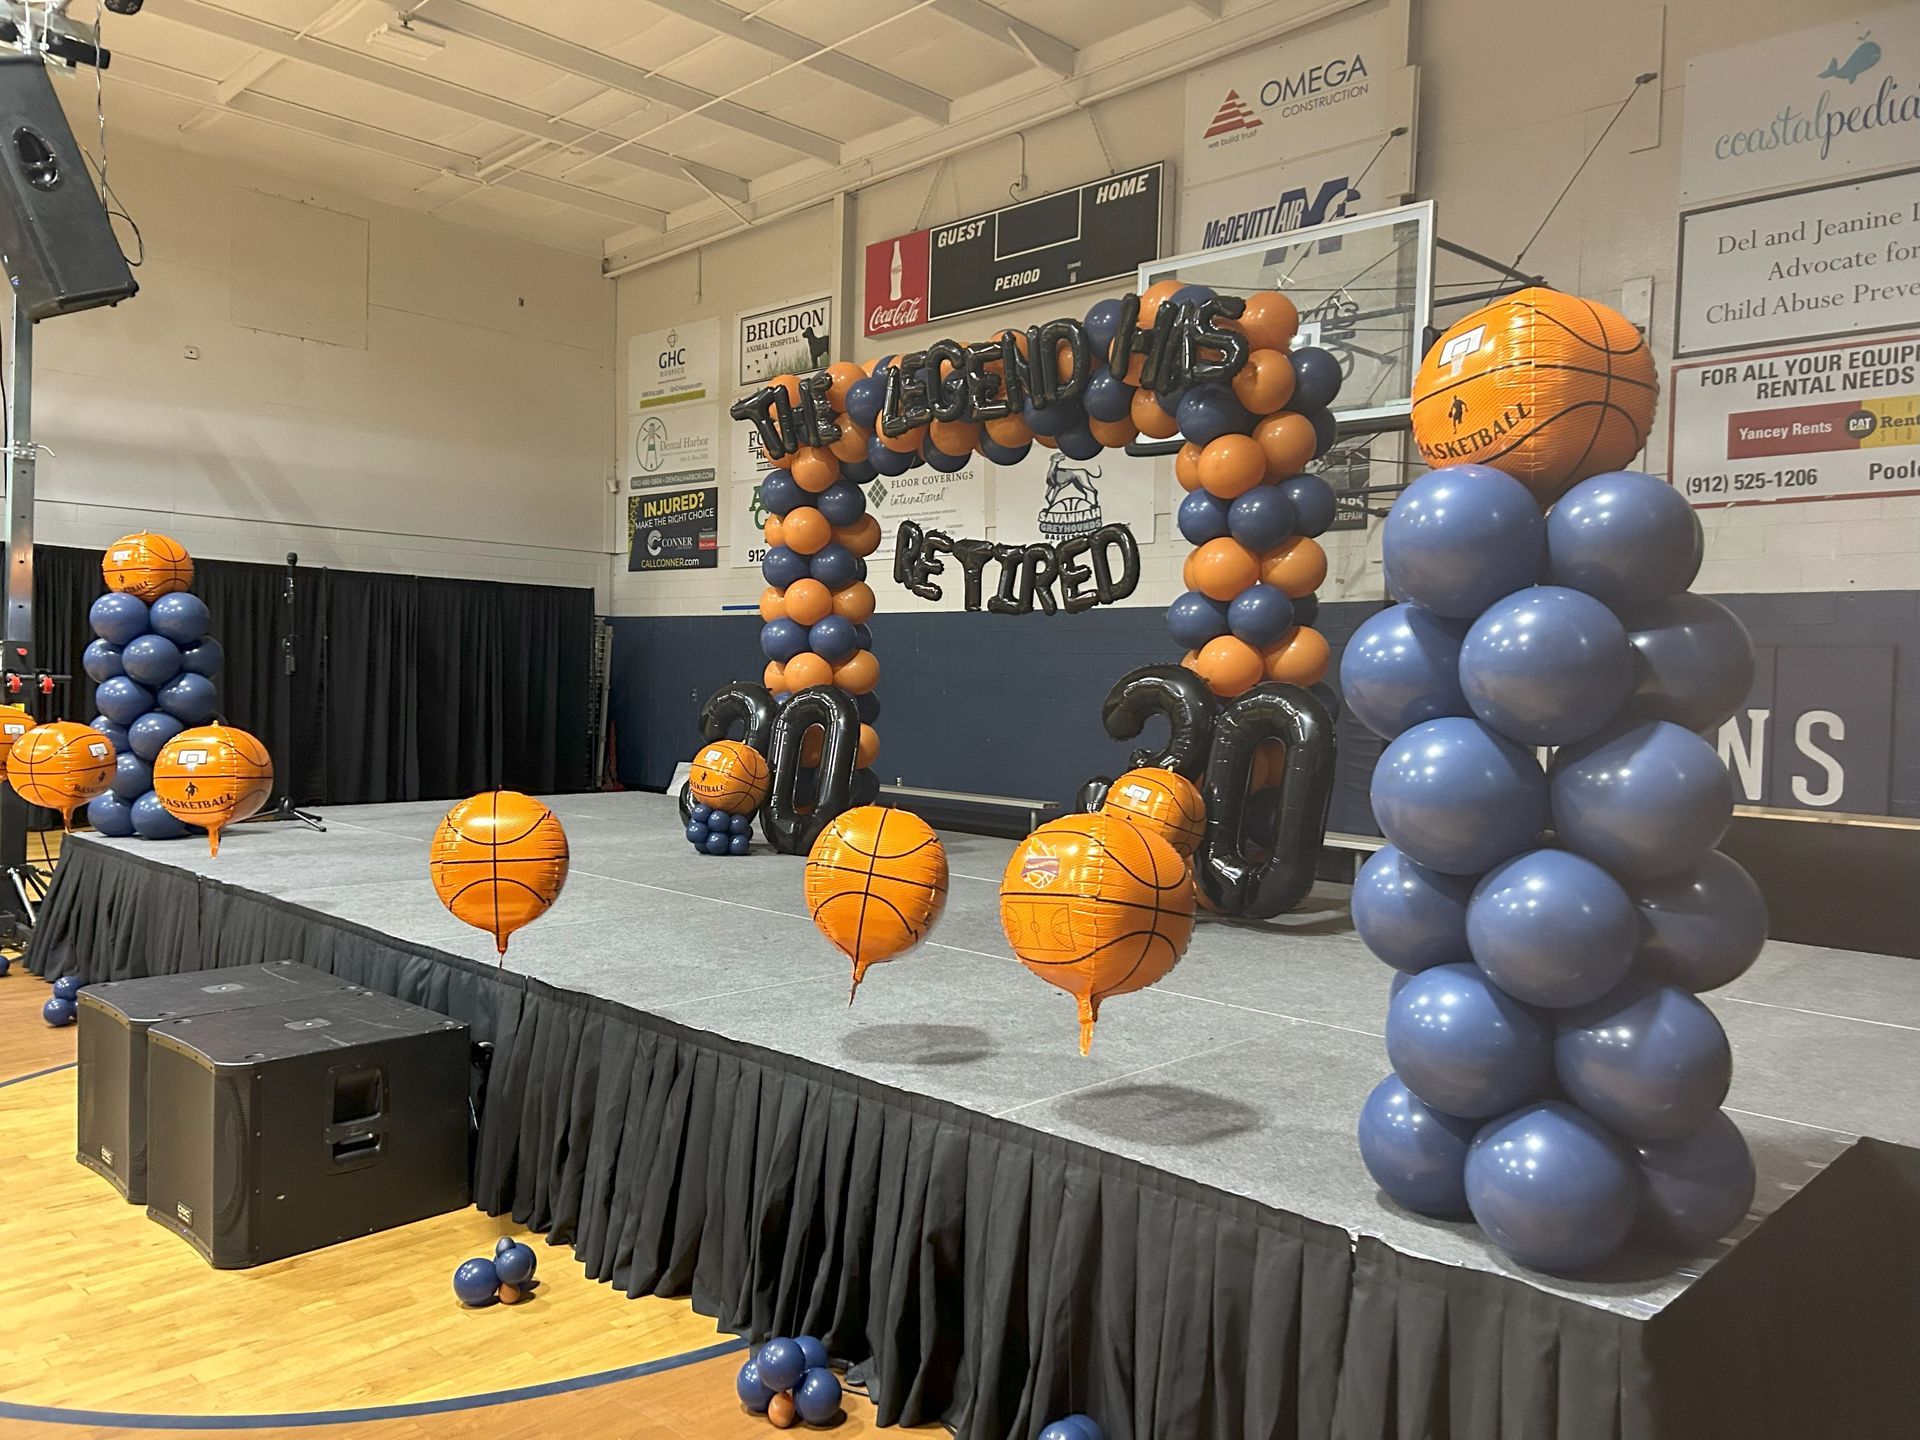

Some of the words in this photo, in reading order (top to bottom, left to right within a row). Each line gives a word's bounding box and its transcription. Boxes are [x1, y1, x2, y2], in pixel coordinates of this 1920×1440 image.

[1260, 54, 1368, 107] OMEGA
[1282, 83, 1369, 118] CONSTRUCTION
[1208, 140, 1219, 149] we
[1220, 132, 1239, 146] build
[1241, 129, 1258, 141] trust
[1095, 173, 1150, 205] HOME
[937, 220, 986, 248] GUEST
[1202, 206, 1276, 250] McDEVITT
[1273, 198, 1305, 235] AIR
[1717, 229, 1757, 255] Del
[1764, 221, 1805, 247] and
[1813, 211, 1903, 245] Jeanine
[995, 268, 1041, 292] PERIOD
[1767, 256, 1878, 281] Advocate
[1705, 297, 1767, 324] Child
[1772, 292, 1845, 315] Abuse
[746, 307, 825, 343] BRIGDON
[746, 343, 769, 353] ANIMAL
[770, 336, 799, 347] HOSPITAL
[658, 348, 686, 369] GHC
[1701, 367, 1738, 387] FOR
[1743, 361, 1779, 382] ALL
[1784, 354, 1843, 378] YOUR
[660, 367, 685, 377] HOSPICE
[1756, 375, 1836, 400] RENTAL
[1842, 366, 1915, 391] NEEDS
[730, 371, 842, 459] THE
[881, 318, 1091, 438] LEGEND
[1739, 427, 1789, 440] Yancey
[1792, 421, 1833, 435] Rents
[1849, 416, 1872, 431] CAT
[660, 438, 681, 452] Dental
[683, 434, 709, 449] Harbor
[891, 479, 919, 489] FLOOR
[922, 470, 974, 486] COVERINGS
[1686, 474, 1729, 496] (912)
[1733, 468, 1818, 491] 525-1206
[644, 491, 705, 518] INJURED?
[890, 486, 948, 507] international
[636, 518, 653, 530] MAKE
[654, 517, 667, 526] THE
[668, 513, 687, 524] RIGHT
[688, 508, 714, 521] CHOICE
[1039, 505, 1101, 524] SAVANNAH
[1040, 520, 1101, 533] GREYHOUNDS
[1338, 511, 1364, 521] REPAIR
[662, 536, 693, 547] CONNER
[641, 558, 700, 568] CALLCONNER.com
[893, 520, 1141, 616] RETIRED
